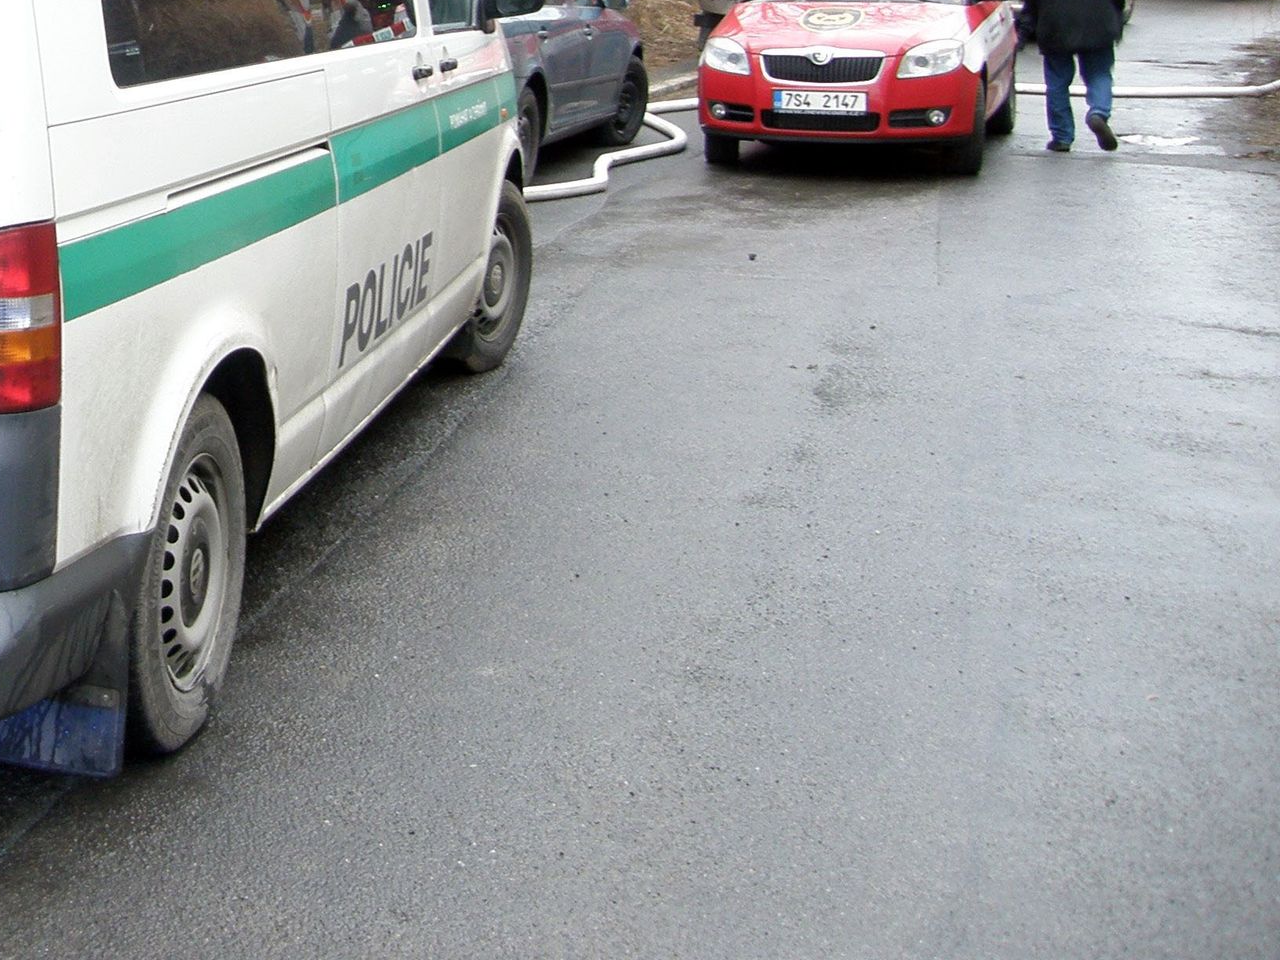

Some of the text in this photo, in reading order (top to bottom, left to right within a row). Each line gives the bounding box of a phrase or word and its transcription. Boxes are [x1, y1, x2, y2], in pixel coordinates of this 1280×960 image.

[784, 92, 859, 109] 7S4 2147
[338, 231, 433, 369] POLICIE
